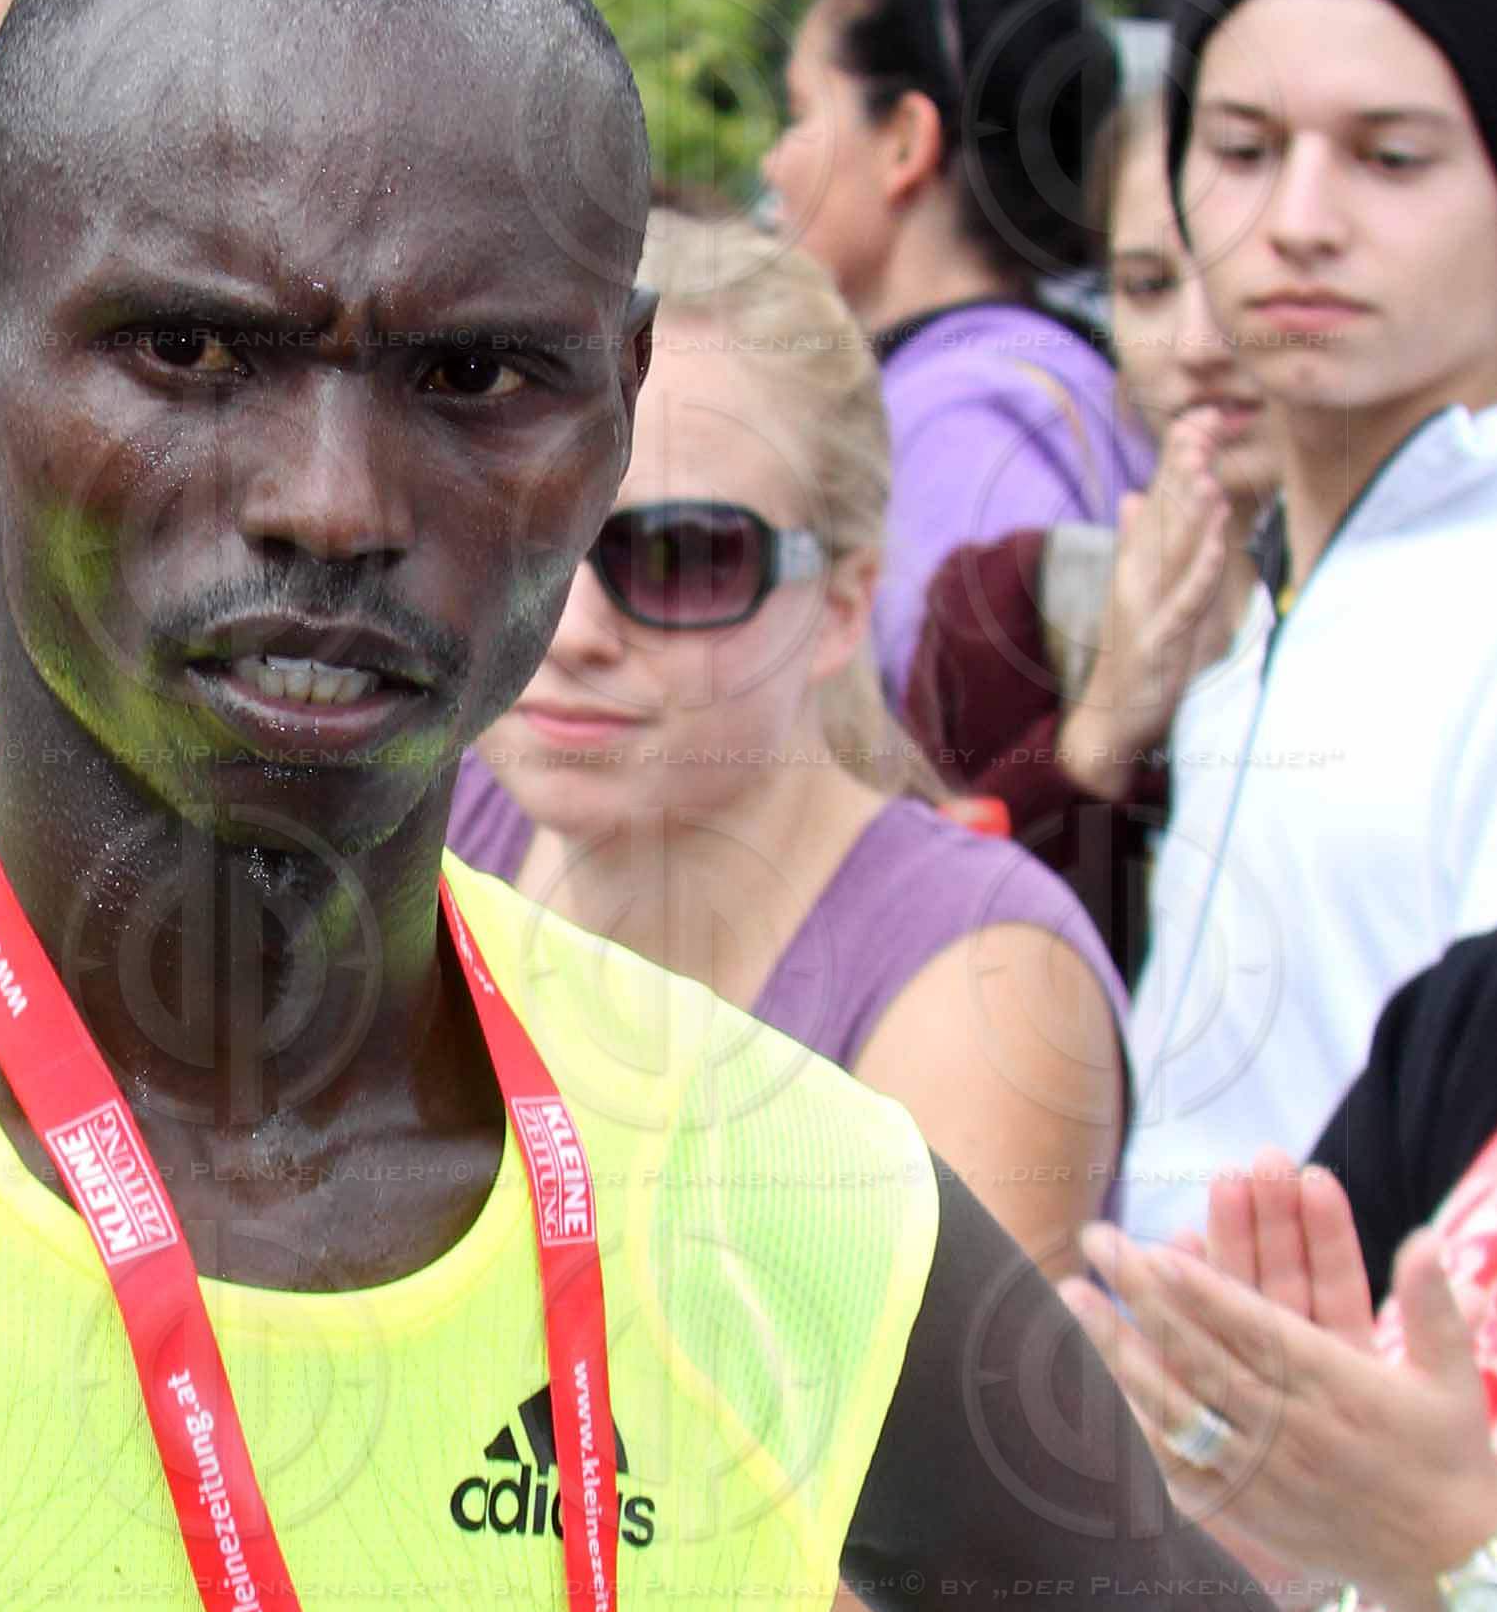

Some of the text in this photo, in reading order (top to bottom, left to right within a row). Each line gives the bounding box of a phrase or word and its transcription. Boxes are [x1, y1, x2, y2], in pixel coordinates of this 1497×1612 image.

[58, 1128, 140, 1256] KLEINE
[92, 1112, 167, 1243] ZEITUNG
[518, 1106, 560, 1239] ZEITUNG
[543, 1103, 588, 1236] KLEINE
[449, 1465, 656, 1548] adis
